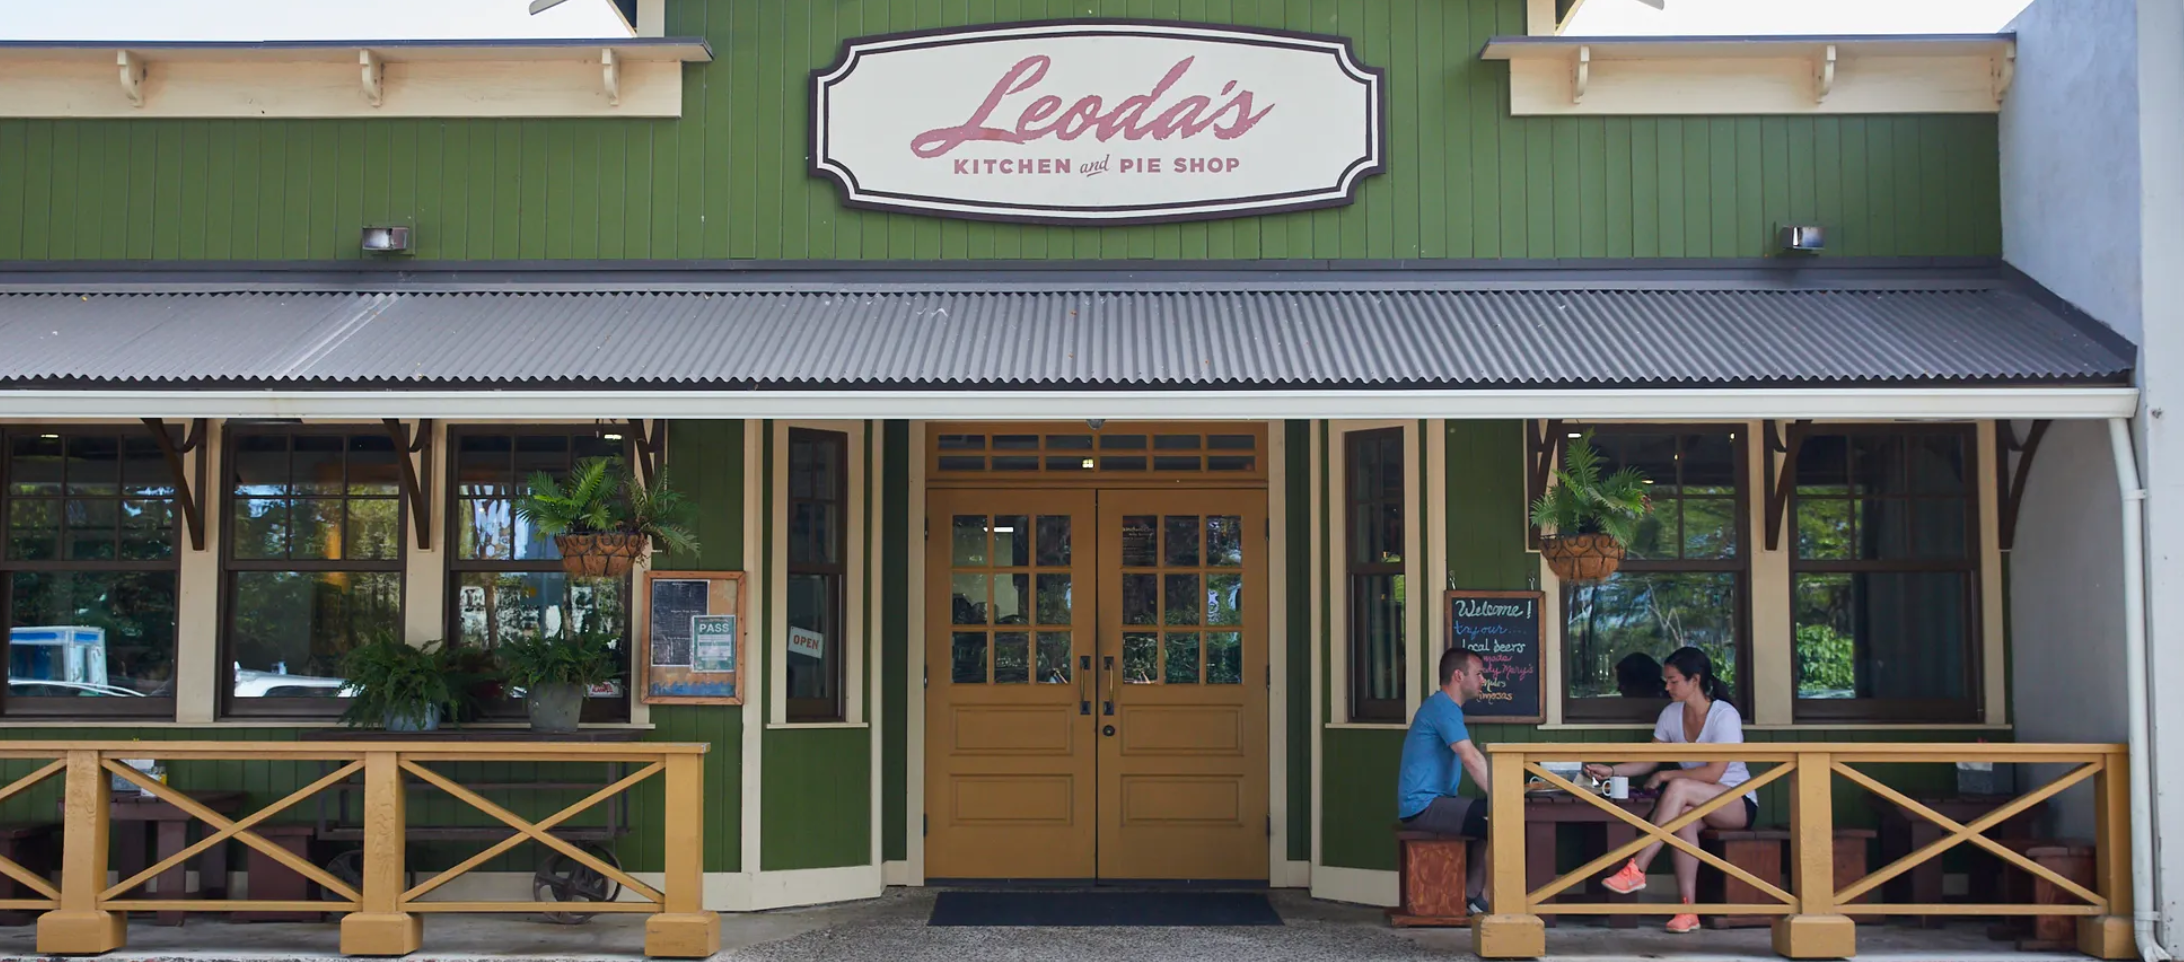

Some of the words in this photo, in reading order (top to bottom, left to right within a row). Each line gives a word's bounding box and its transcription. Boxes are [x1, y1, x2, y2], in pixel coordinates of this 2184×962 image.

[910, 54, 1276, 159] Leoda's
[953, 158, 1071, 174] KITCHEN
[1079, 154, 1110, 178] and
[1120, 158, 1161, 173] PIE
[1174, 157, 1240, 173] SHOP
[699, 623, 730, 633] PASS
[793, 634, 819, 650] OPEN
[1493, 638, 1526, 653] beers
